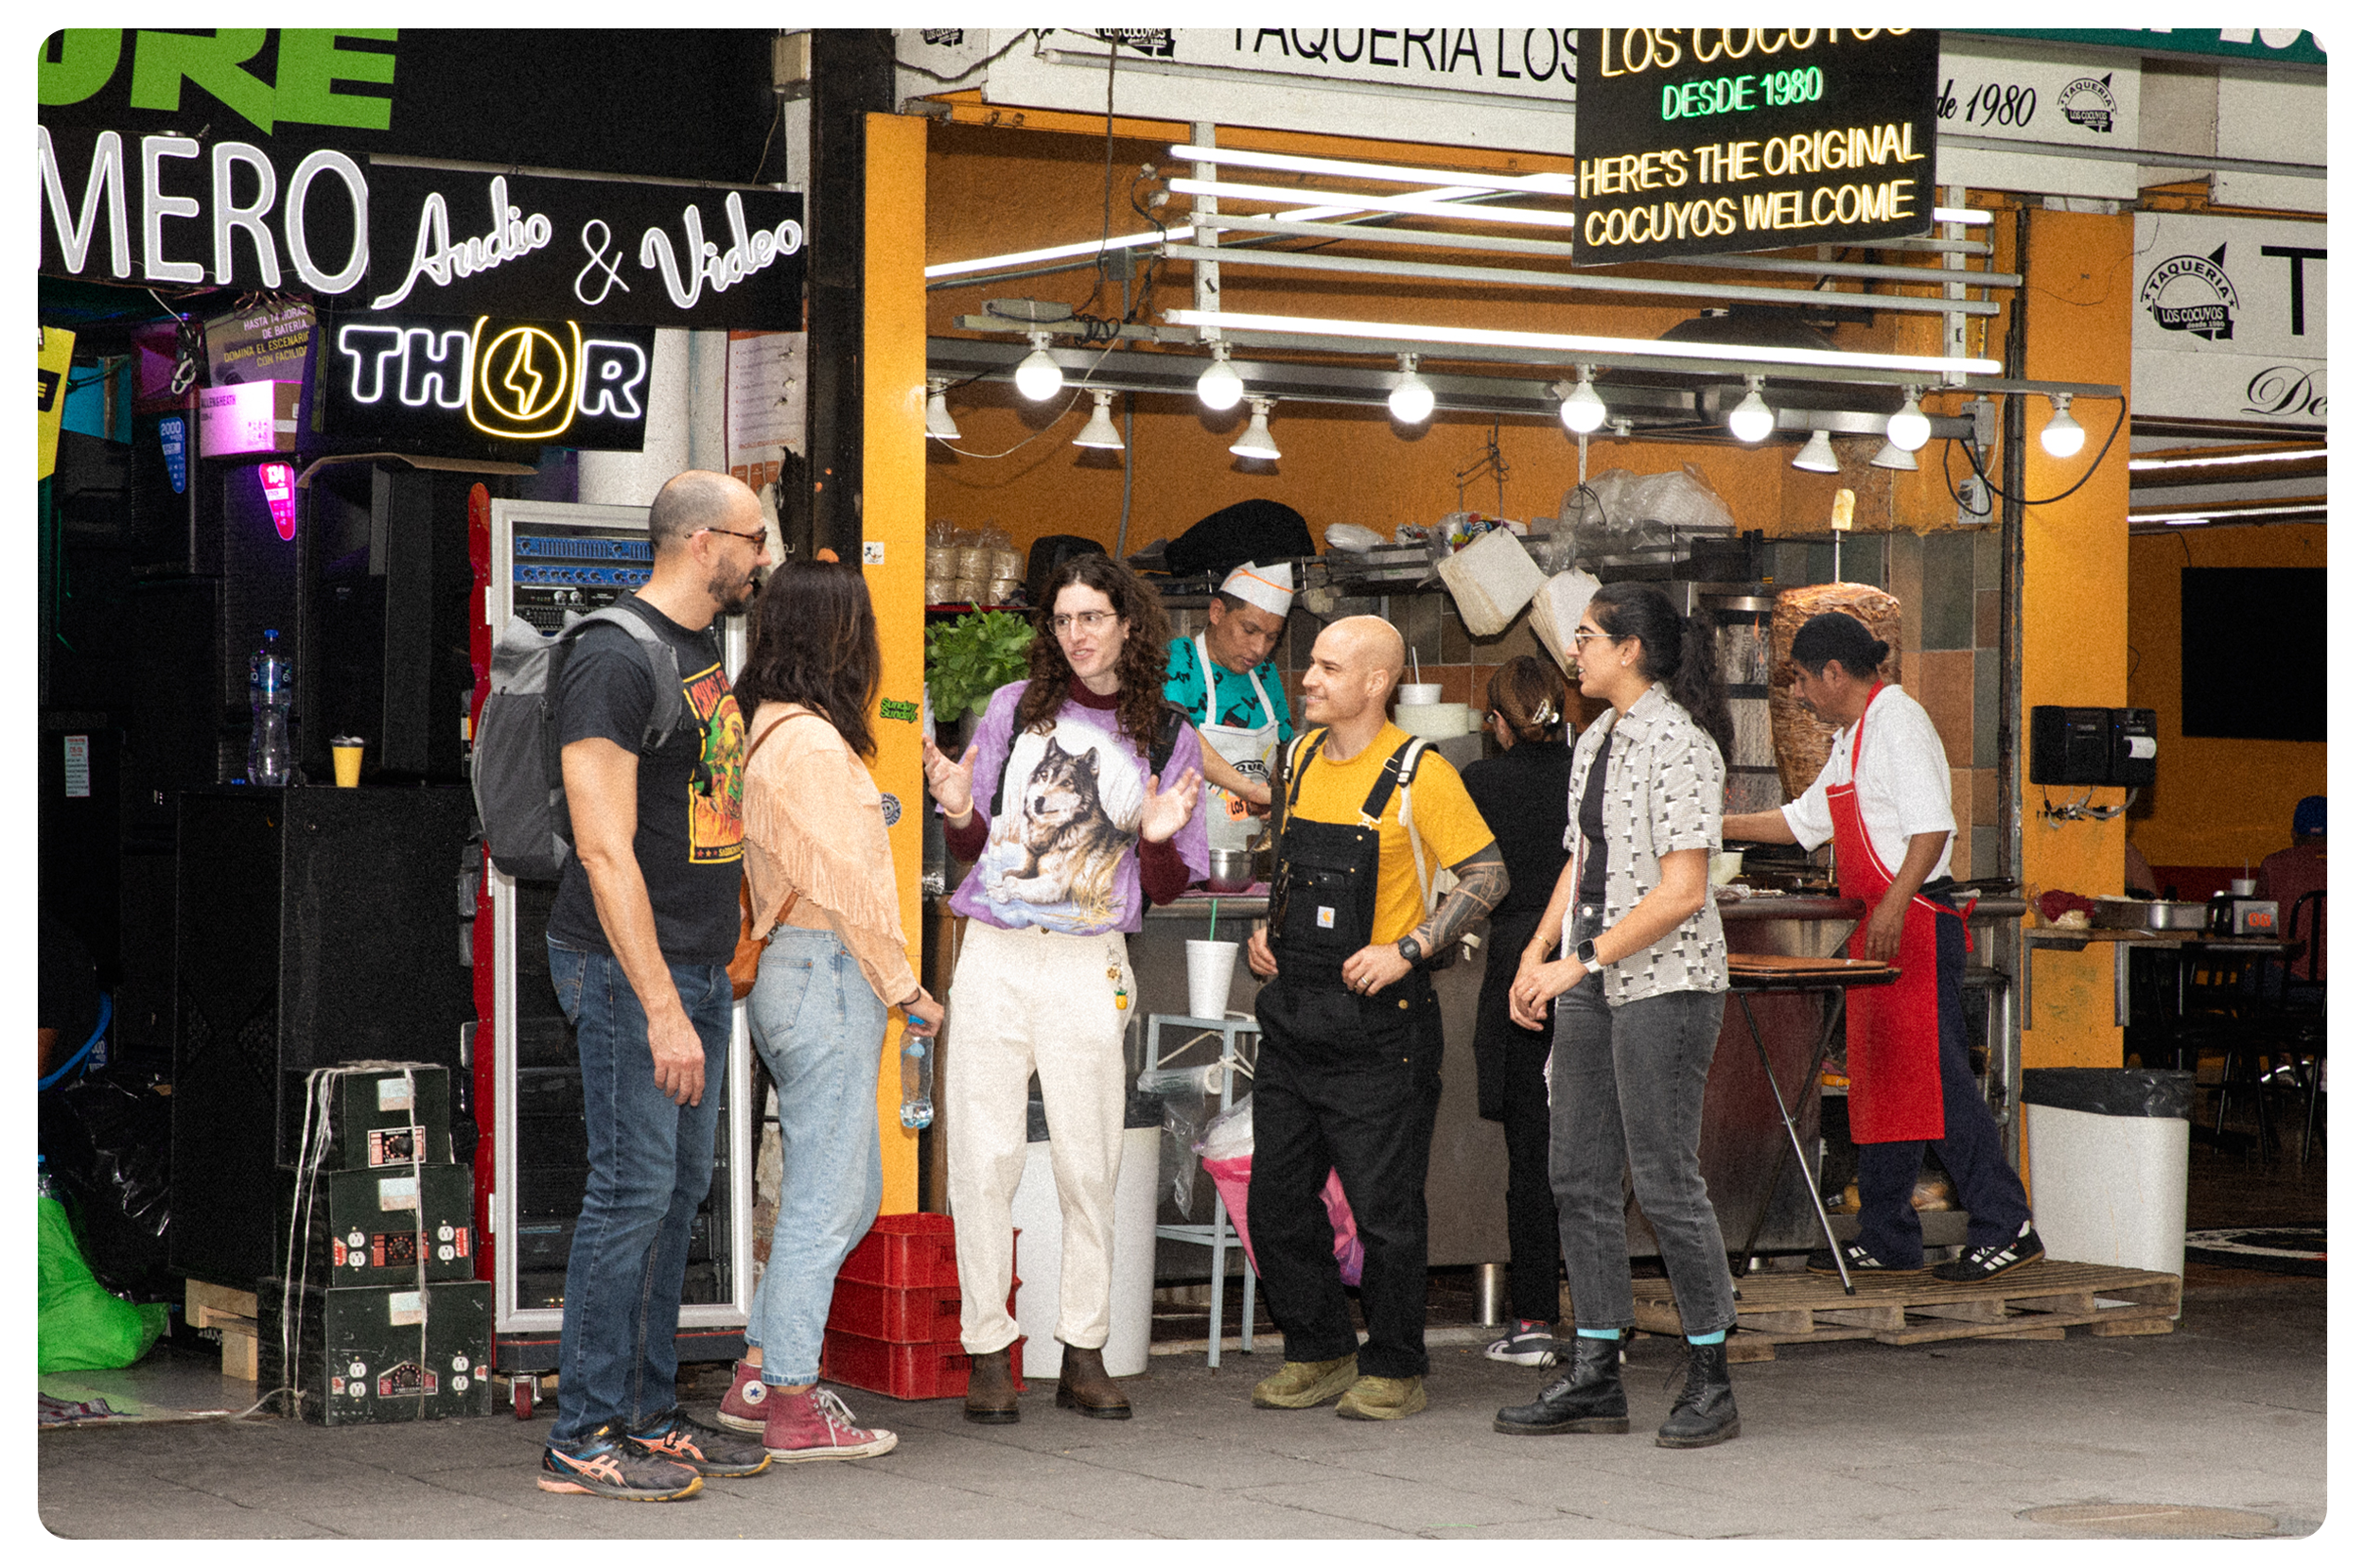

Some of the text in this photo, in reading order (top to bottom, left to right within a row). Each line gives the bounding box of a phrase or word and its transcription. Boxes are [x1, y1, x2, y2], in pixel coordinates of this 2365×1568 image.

[1601, 28, 1681, 77] LOS
[1662, 66, 1823, 121] DESDE 1980
[1966, 83, 2037, 128] 1980
[2063, 81, 2111, 107] TAQUERIA
[1579, 122, 1925, 199] HERE'S THE ORIGINAL
[1584, 179, 1916, 246] COCUYOS WELCOME
[370, 175, 802, 310] Audio & Video
[2149, 260, 2229, 298] TAQUERIA
[244, 305, 308, 331] HASTA 14 HORAS
[2162, 306, 2224, 322] LOS COCUYOS
[262, 328, 272, 340] DE
[224, 346, 254, 362] DOMINA
[256, 343, 266, 354] EL
[256, 356, 274, 368] CON
[160, 421, 181, 436] 2000
[881, 697, 919, 712] Sunday
[1231, 800, 1244, 814] LOS
[2248, 913, 2272, 928] 08
